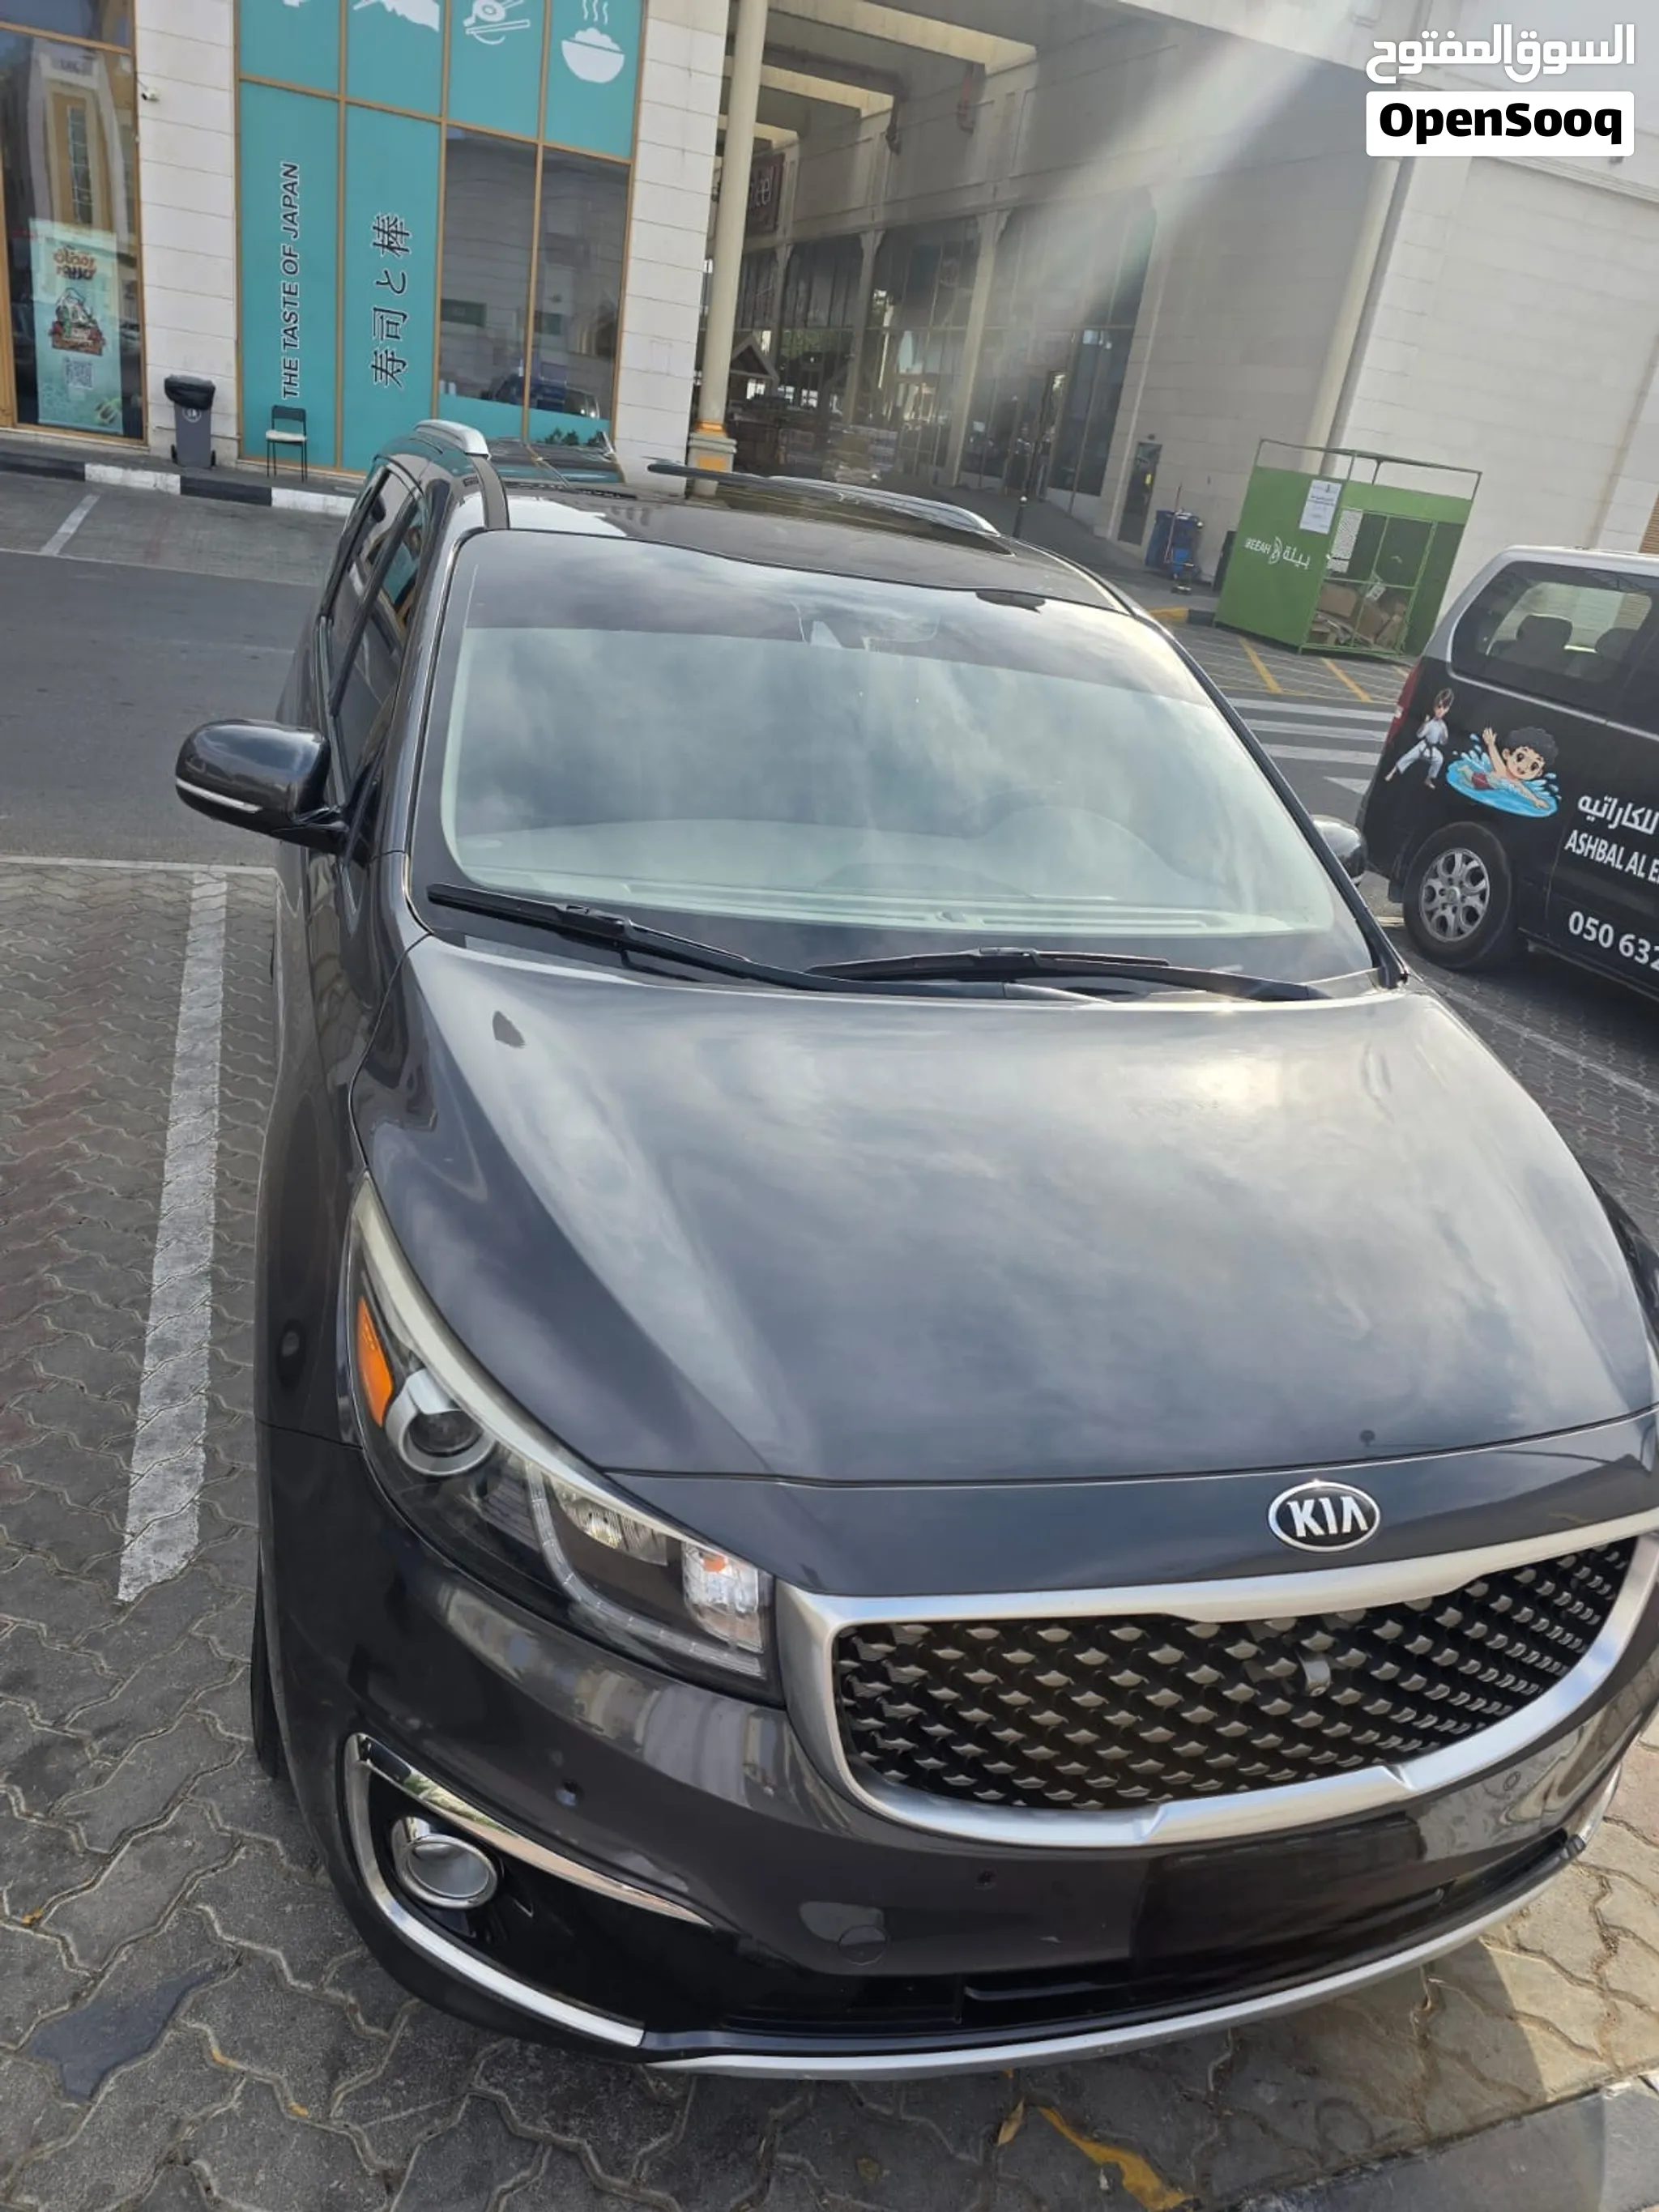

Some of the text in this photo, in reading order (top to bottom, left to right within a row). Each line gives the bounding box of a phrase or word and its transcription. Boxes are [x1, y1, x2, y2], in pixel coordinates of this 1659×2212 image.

[282, 161, 300, 399] THE TASTE OF JAPAN
[1564, 829, 1624, 870] ASHBAL
[1624, 851, 1647, 878] AL
[1568, 910, 1614, 948] 050
[1286, 1495, 1369, 1538] KIA
